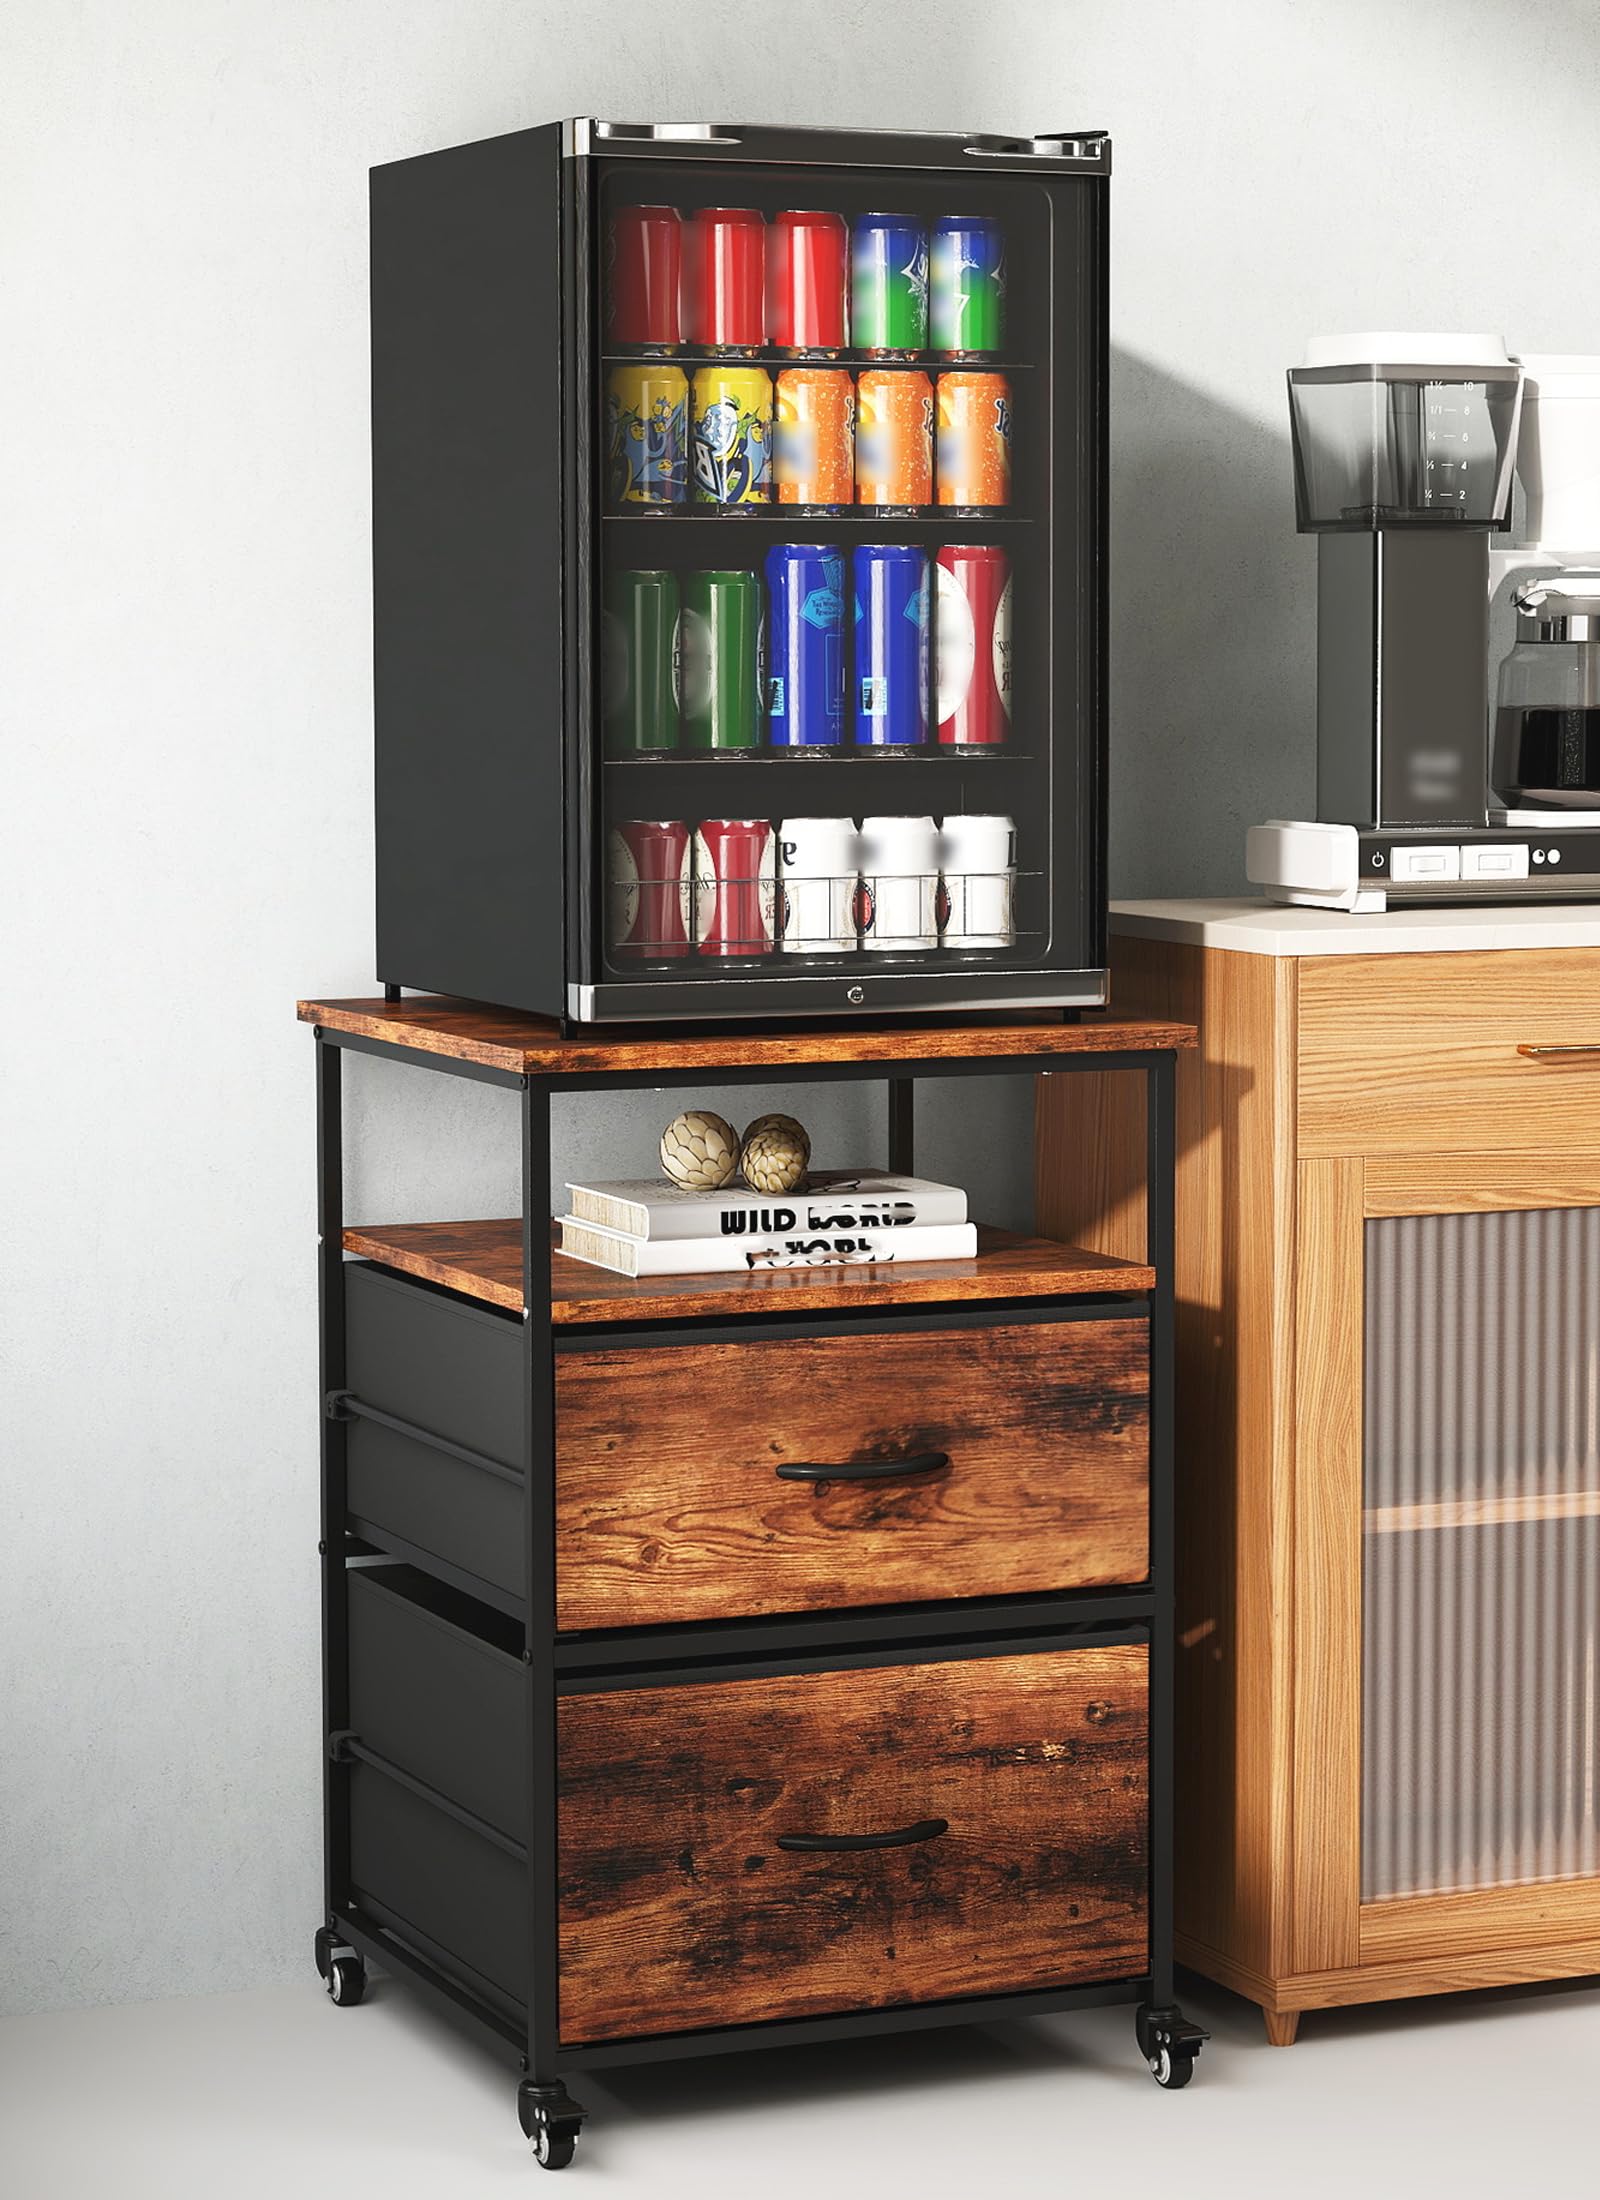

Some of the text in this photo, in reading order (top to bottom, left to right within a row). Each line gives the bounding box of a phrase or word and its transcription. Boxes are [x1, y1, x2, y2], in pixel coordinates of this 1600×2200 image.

[1464, 381, 1474, 391] 10
[1464, 405, 1470, 416] 8
[1462, 432, 1469, 442] 6
[1461, 461, 1467, 470] 4
[1459, 490, 1466, 500] 2
[720, 1208, 797, 1235] WILD
